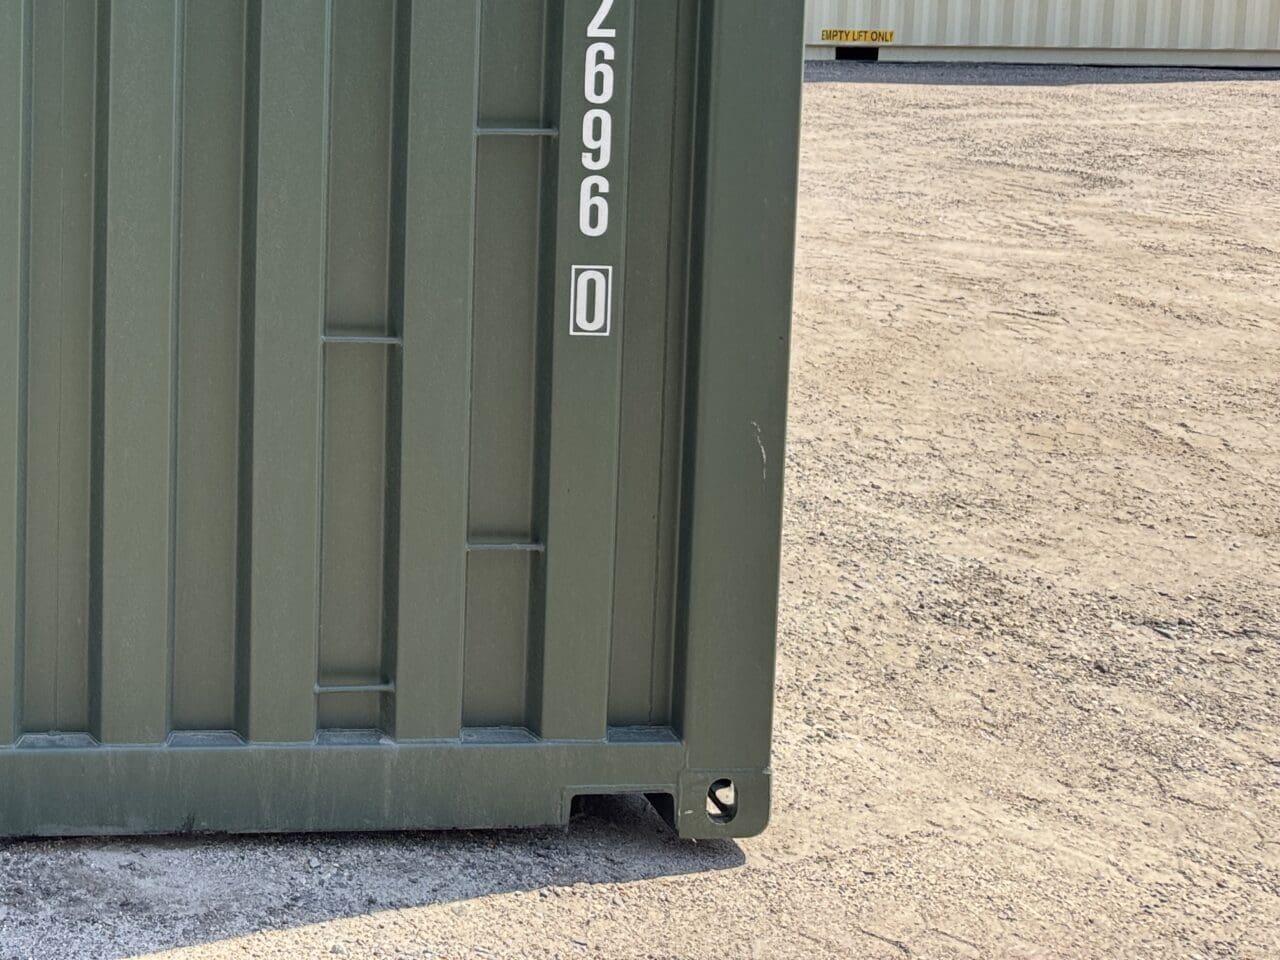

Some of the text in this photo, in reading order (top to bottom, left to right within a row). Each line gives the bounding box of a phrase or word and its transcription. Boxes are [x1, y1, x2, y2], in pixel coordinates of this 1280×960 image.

[821, 29, 894, 42] EMPTY LIFT ONLY
[573, 268, 608, 333] 0
